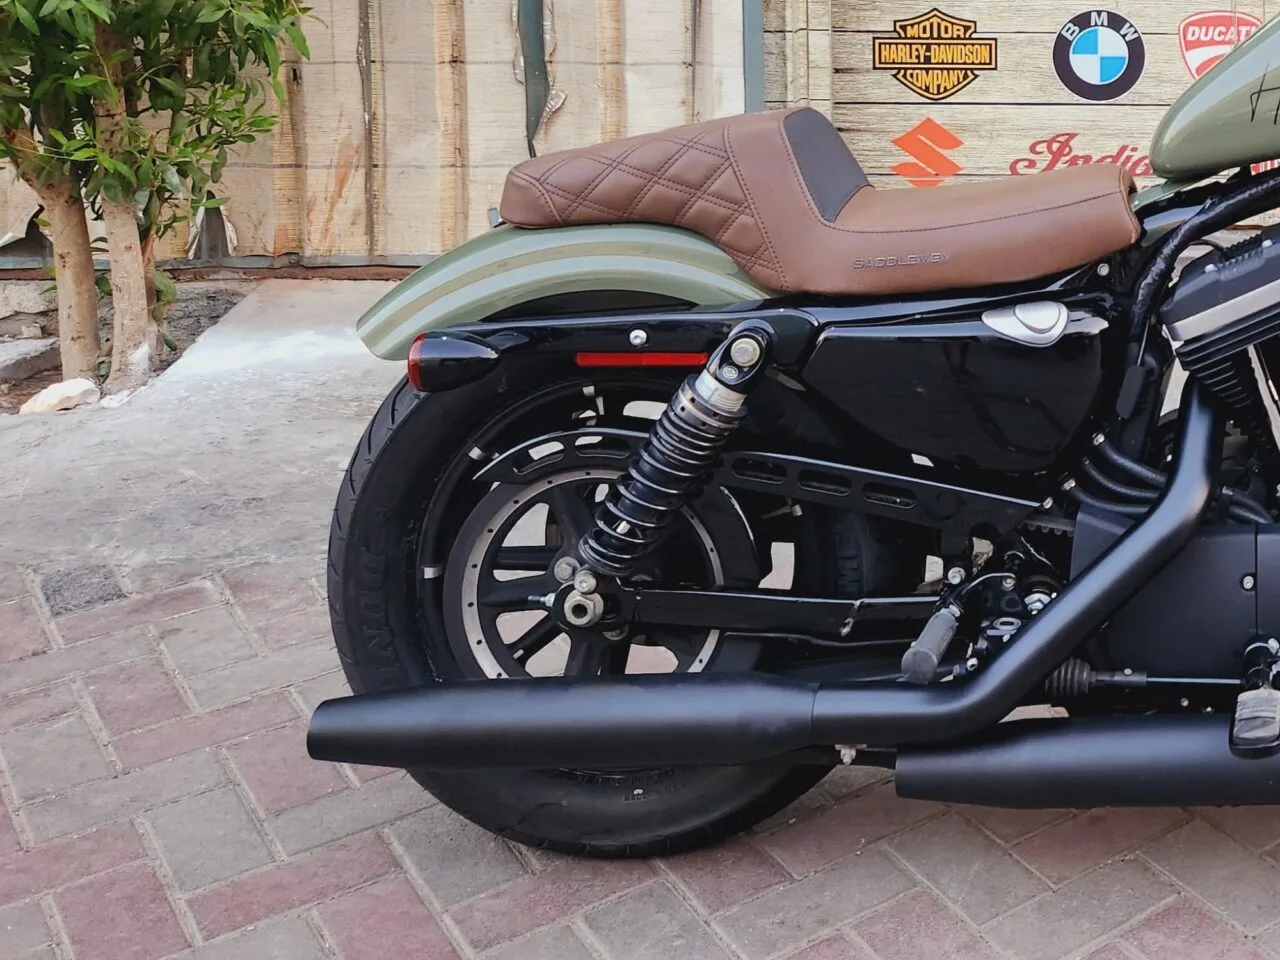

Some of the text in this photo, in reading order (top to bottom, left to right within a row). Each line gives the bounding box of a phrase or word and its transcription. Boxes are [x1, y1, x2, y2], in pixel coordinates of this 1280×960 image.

[907, 17, 965, 38] MOTOR
[1061, 11, 1140, 42] BMW
[881, 44, 990, 64] HARLEY-DAVIDSON
[907, 69, 966, 94] COMPANY
[853, 252, 950, 269] SADDLEMEN
